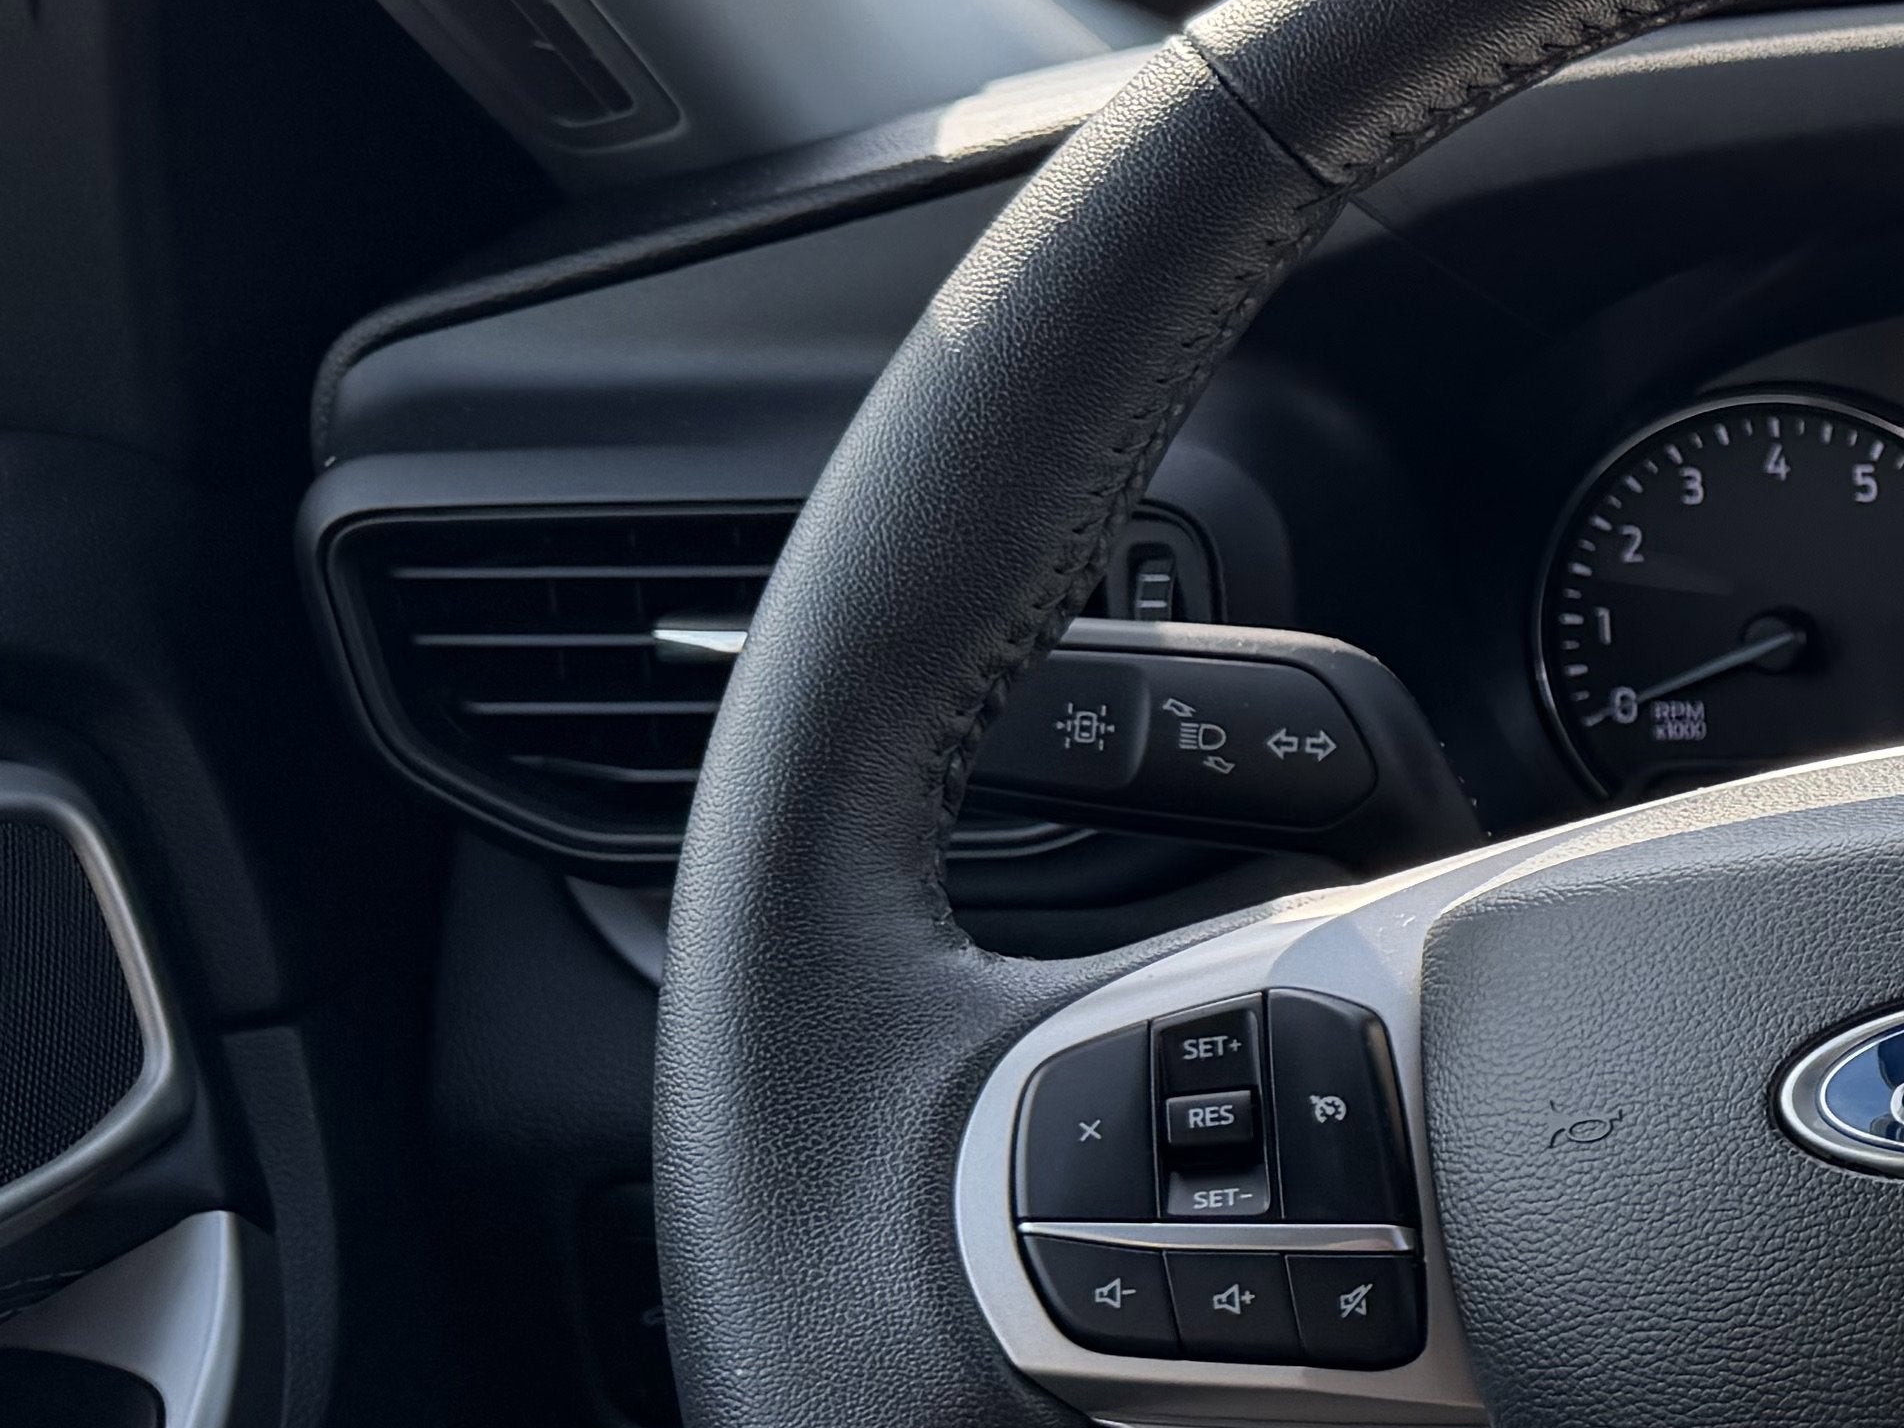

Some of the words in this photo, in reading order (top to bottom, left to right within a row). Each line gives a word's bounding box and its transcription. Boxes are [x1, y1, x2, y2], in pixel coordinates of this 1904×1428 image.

[1765, 443, 1790, 480] 4
[1682, 468, 1705, 504] 3
[1854, 463, 1878, 503] 5
[1620, 524, 1644, 563] 2
[1596, 607, 1612, 645] 1
[1611, 686, 1638, 724] 0
[1655, 700, 1705, 721] RPM
[1183, 1035, 1242, 1060] SET+
[1188, 1105, 1235, 1129] RES
